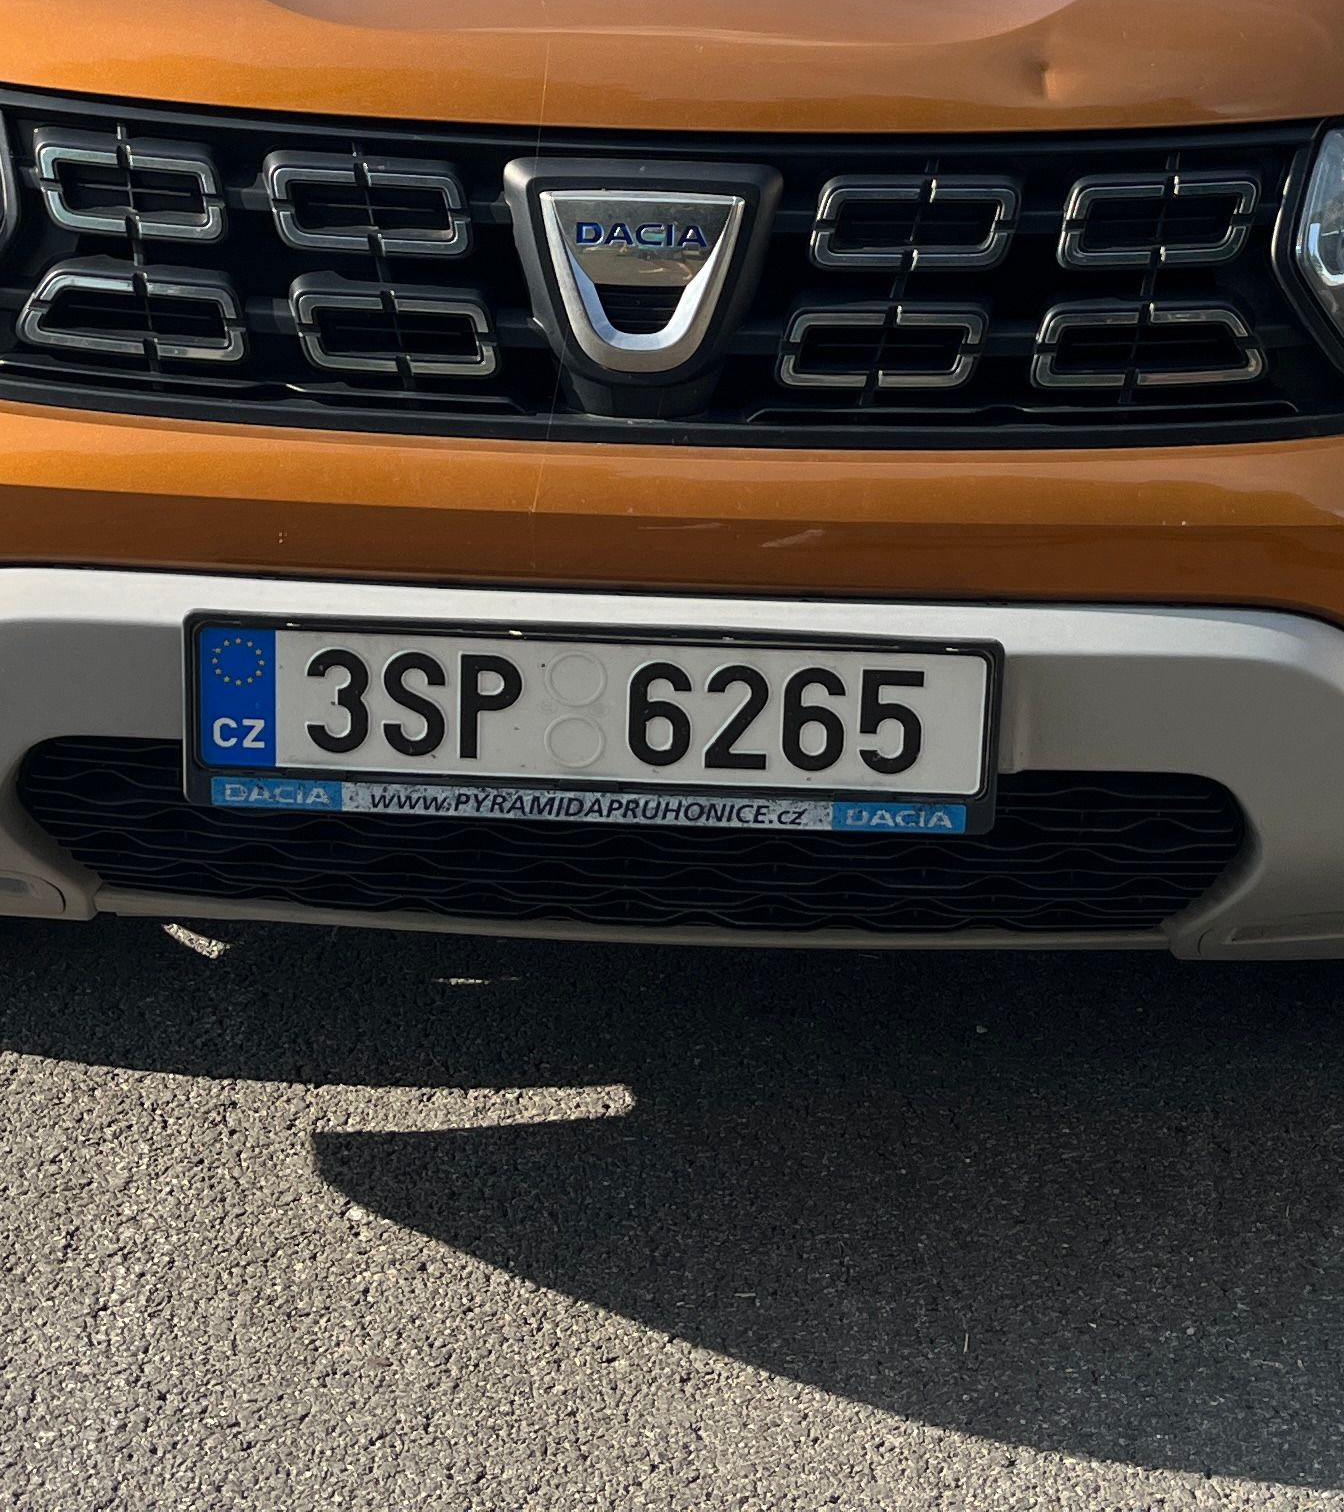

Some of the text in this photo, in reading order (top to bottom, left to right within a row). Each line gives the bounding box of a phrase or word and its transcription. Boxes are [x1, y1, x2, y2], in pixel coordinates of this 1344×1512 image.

[575, 221, 708, 248] DACIA
[306, 648, 925, 774] 3SP 6265
[212, 717, 266, 749] CZ
[224, 784, 330, 805] DACIA
[846, 805, 953, 829] DACIA
